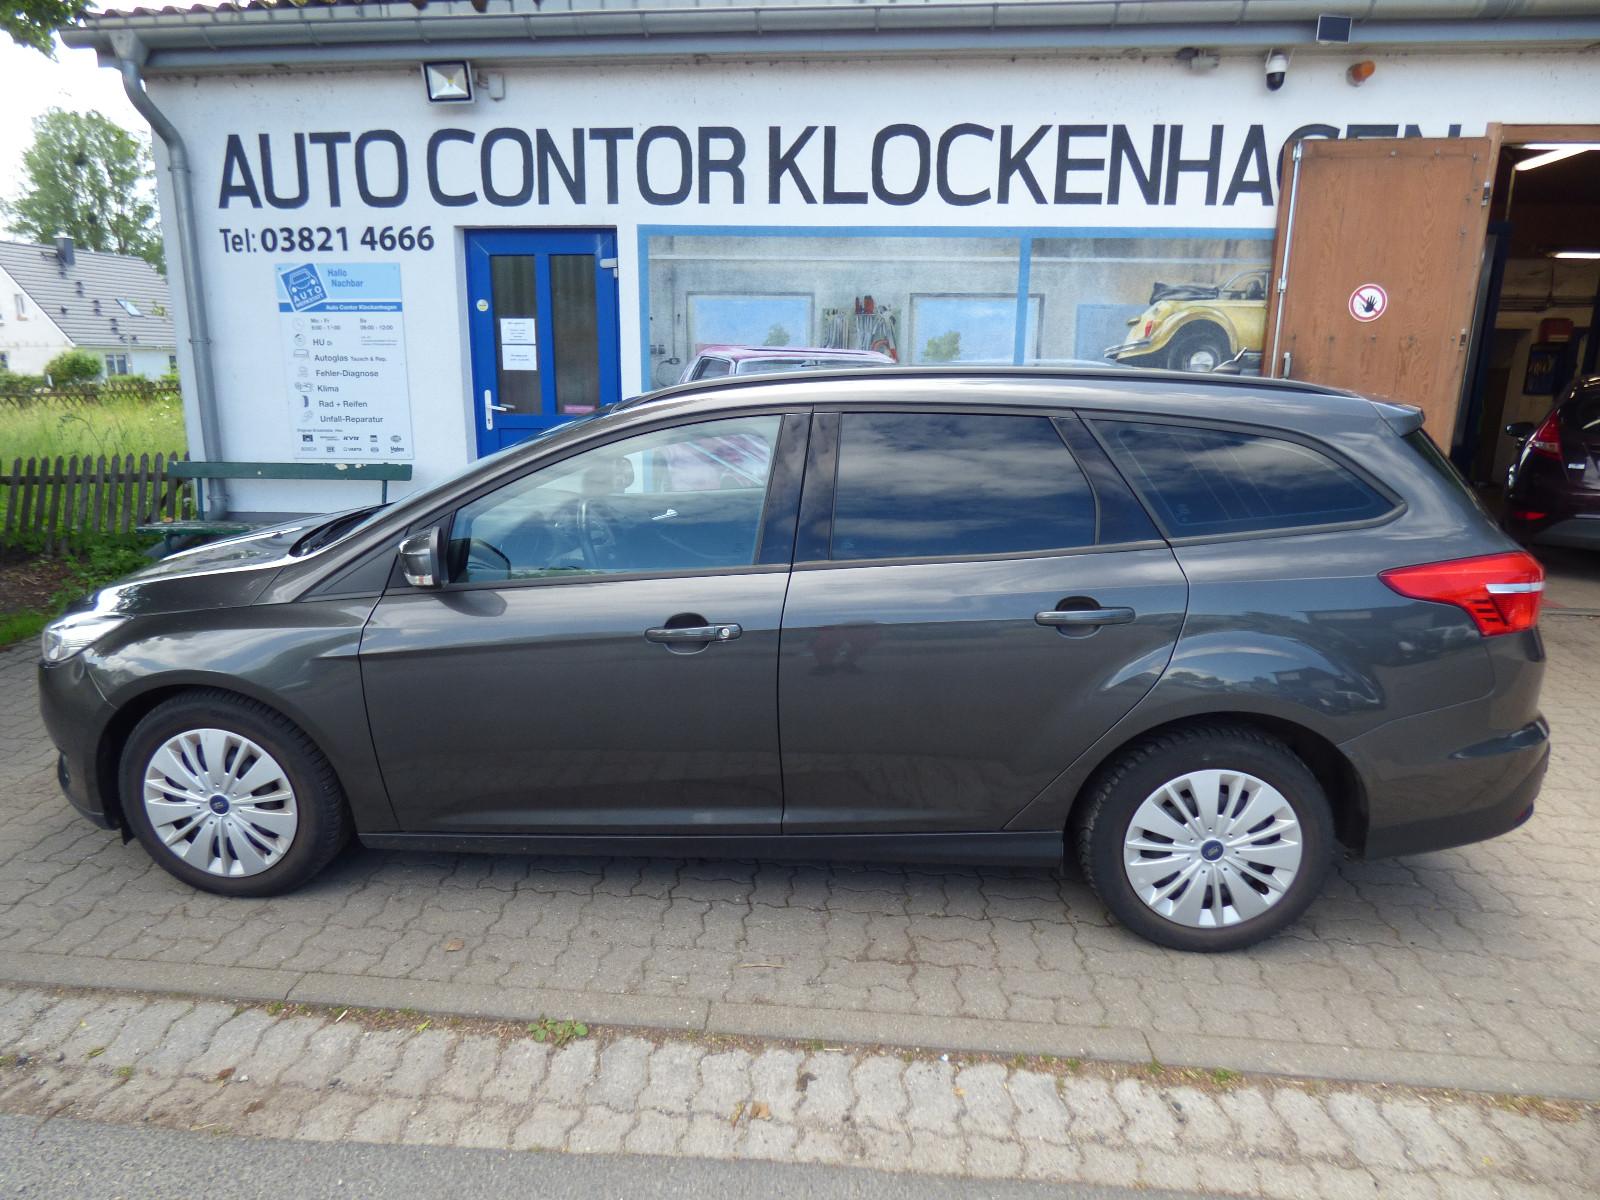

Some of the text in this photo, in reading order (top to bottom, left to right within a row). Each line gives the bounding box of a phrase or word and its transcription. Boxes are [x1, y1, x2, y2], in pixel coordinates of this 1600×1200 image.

[218, 122, 1461, 209] AUTO CONTOR KLOCKENHA
[219, 225, 435, 253] Tel: 03821 4666
[327, 268, 348, 277] Hallo
[331, 279, 364, 288] Nachbar
[293, 286, 322, 303] AUTO
[313, 337, 326, 346] HU
[314, 353, 349, 363] Autoglas
[315, 369, 380, 379] Fehler-Diagnose
[317, 384, 340, 393] Klima
[318, 399, 335, 408] Rad
[342, 399, 368, 408] Reifen
[320, 415, 385, 425] Unfall-Reparatur
